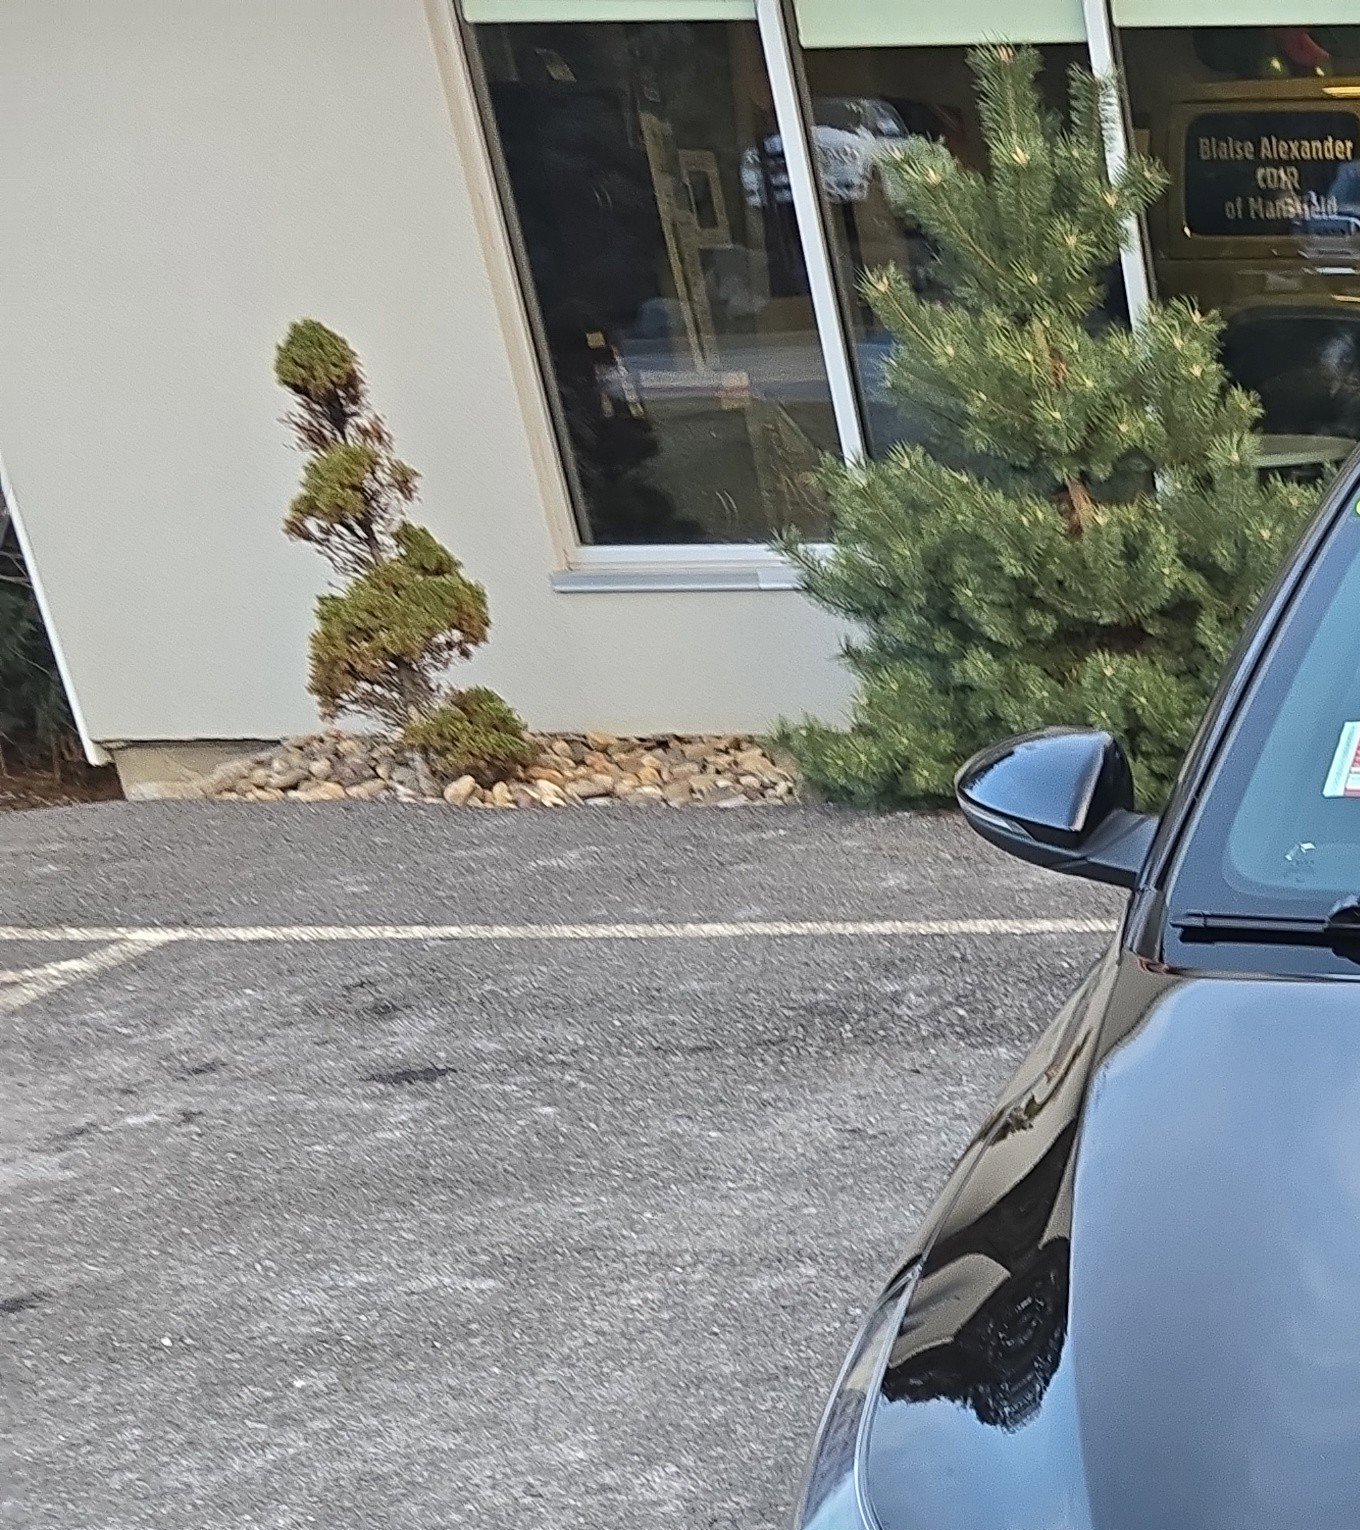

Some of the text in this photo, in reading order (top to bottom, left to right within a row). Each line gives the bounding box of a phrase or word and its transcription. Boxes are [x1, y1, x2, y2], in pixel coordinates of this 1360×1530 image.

[1199, 134, 1354, 161] Blaise Alexander
[1224, 196, 1243, 220] of
